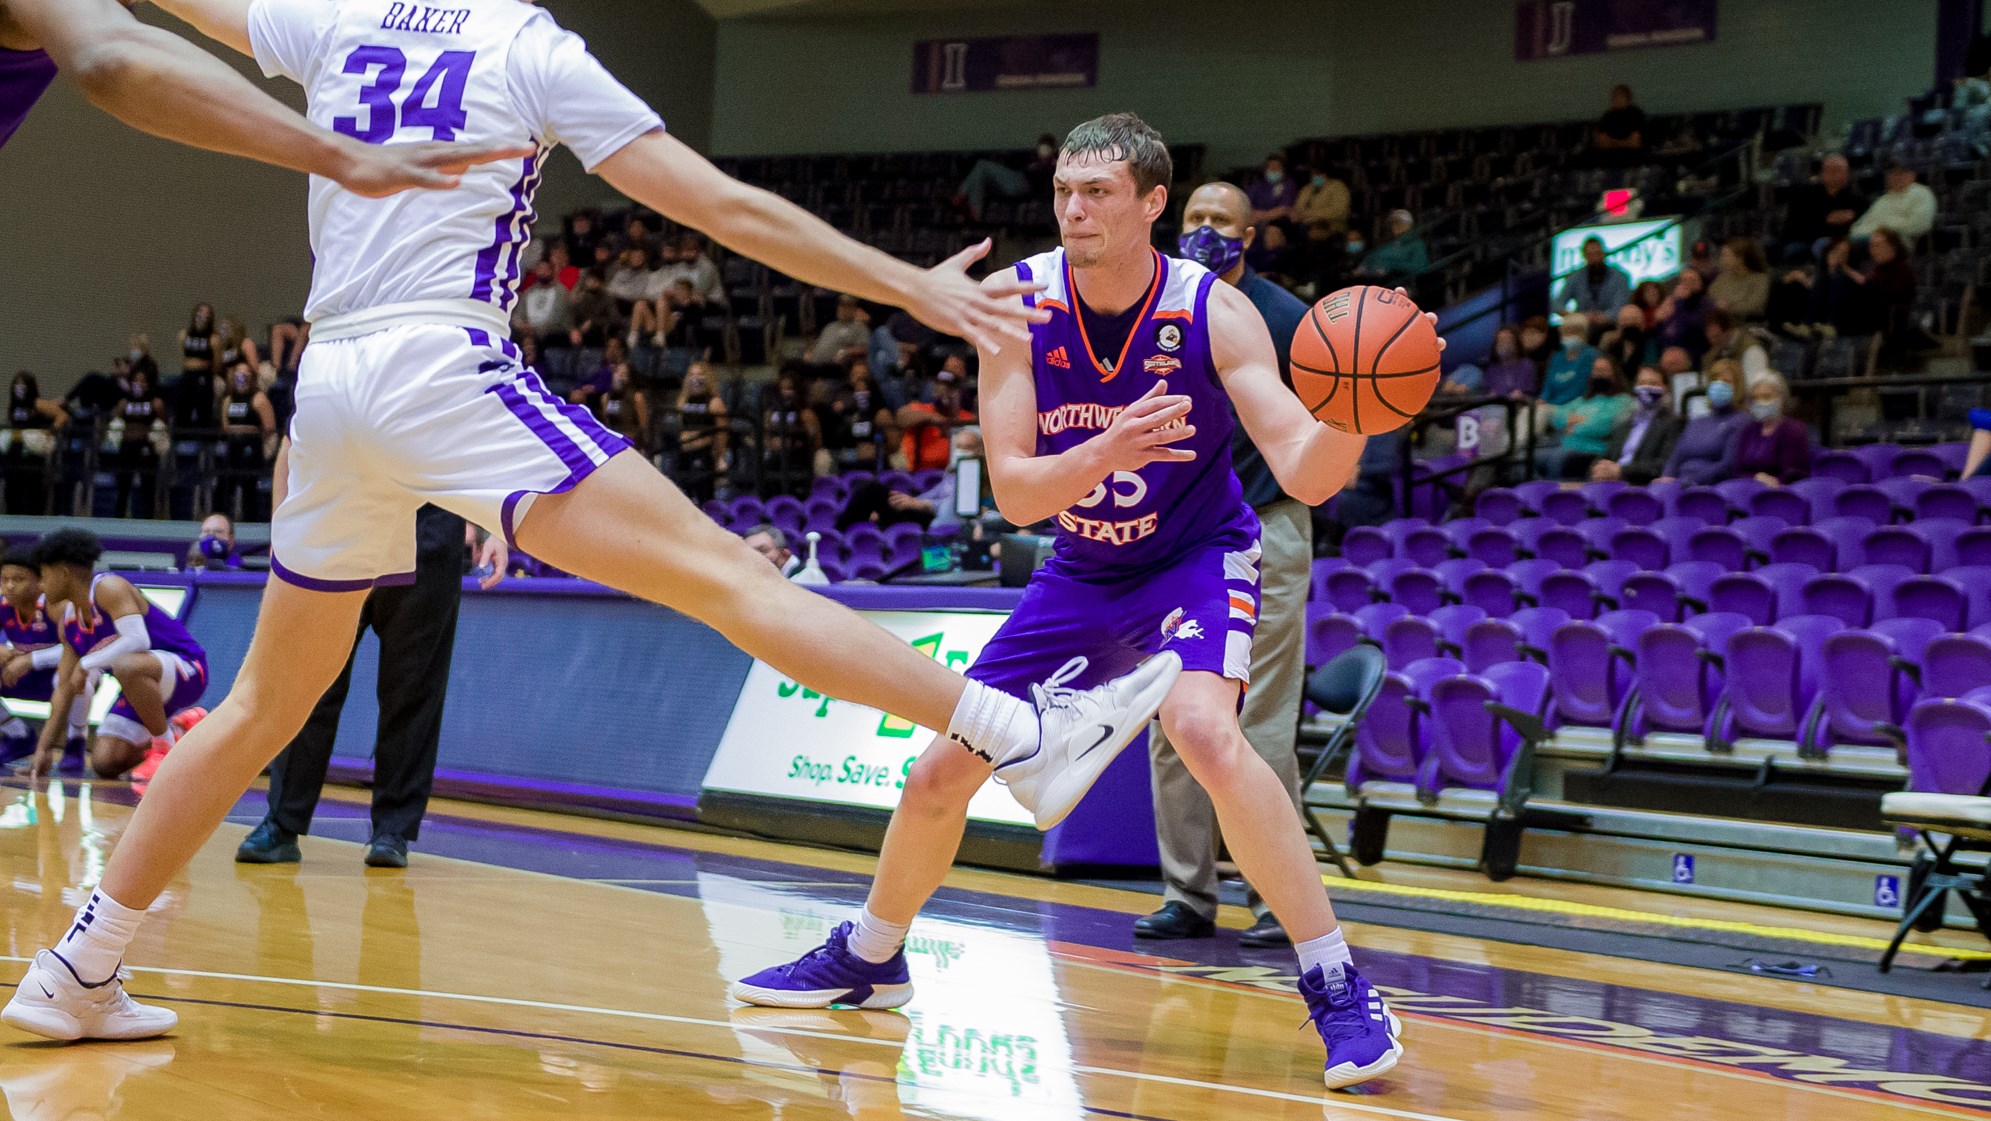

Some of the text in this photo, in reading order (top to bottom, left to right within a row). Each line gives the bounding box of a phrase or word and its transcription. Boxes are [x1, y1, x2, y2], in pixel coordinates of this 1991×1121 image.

[380, 1, 471, 35] BAKER
[333, 44, 477, 145] 34
[1046, 356, 1071, 370] adidas
[1458, 415, 1479, 449] B
[1058, 510, 1158, 546] STATE
[788, 754, 832, 787] Shop.
[837, 755, 890, 788] Save.
